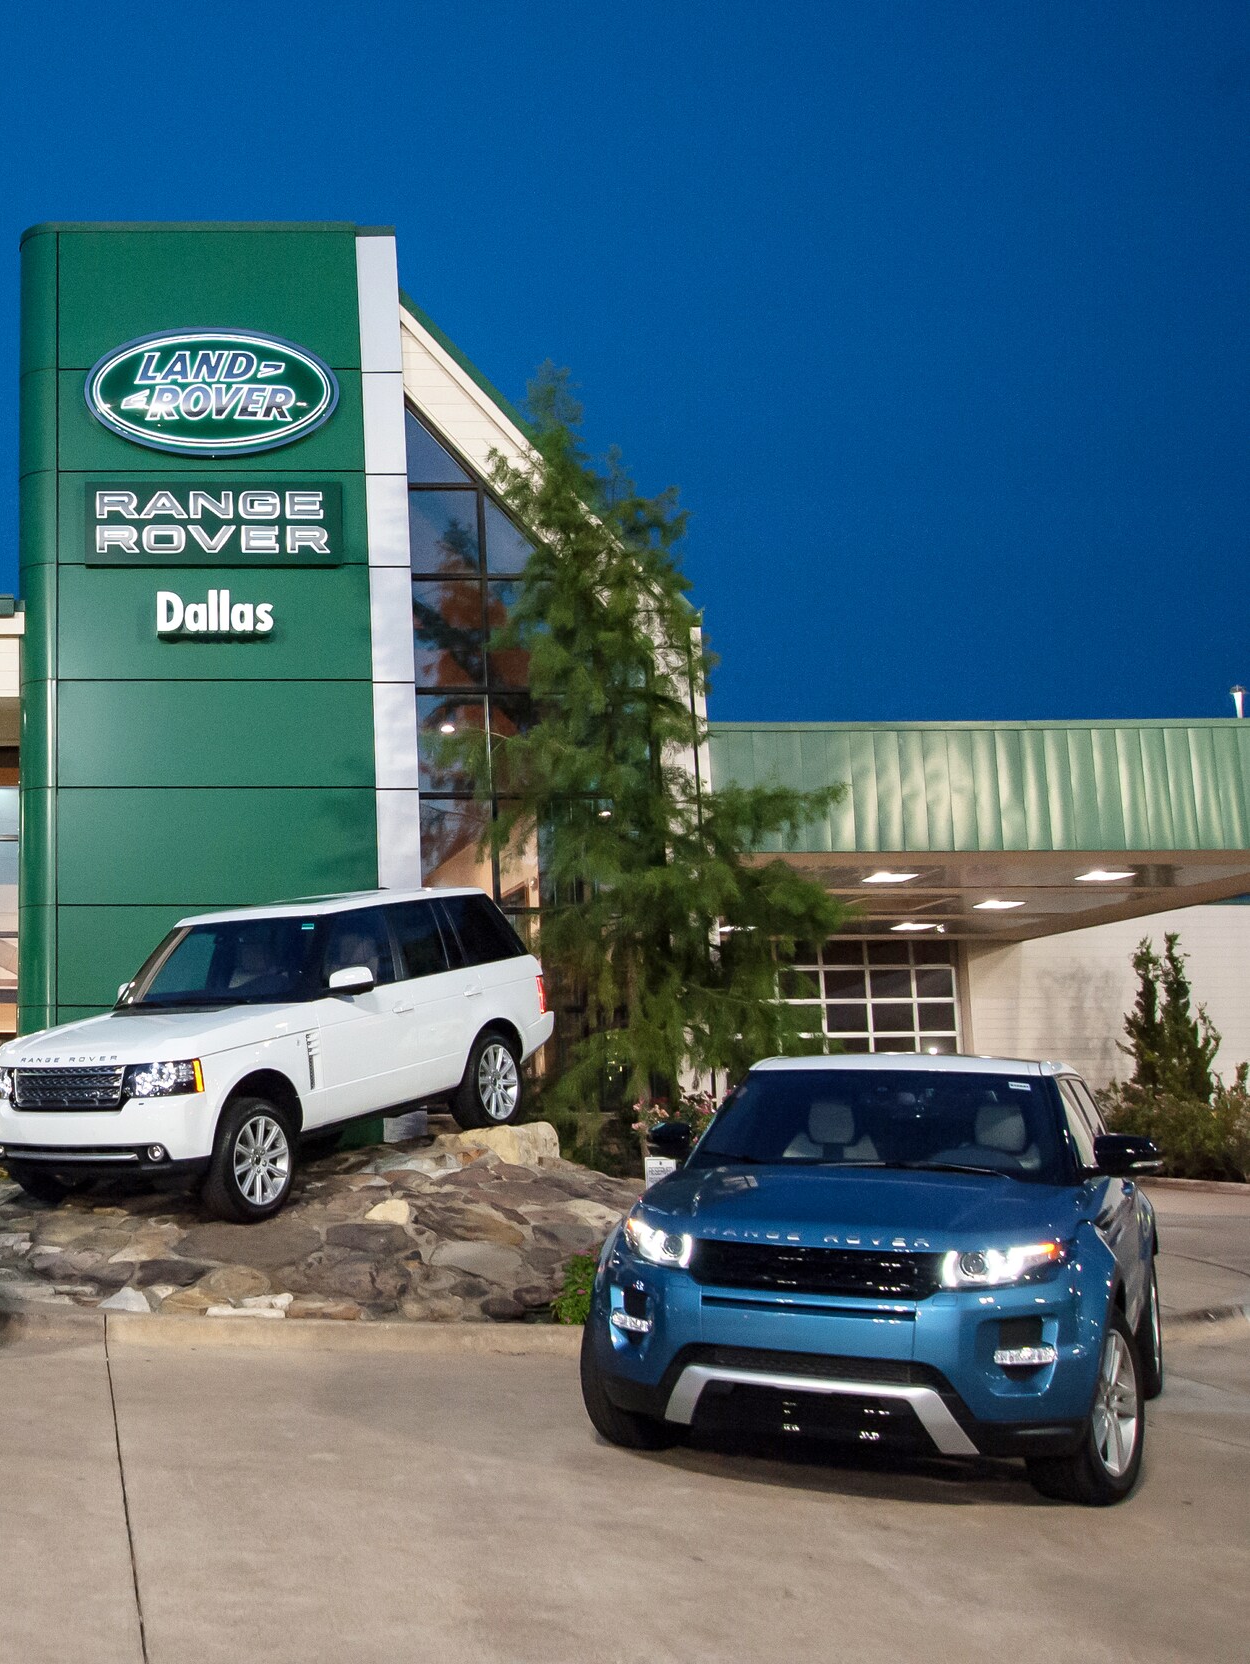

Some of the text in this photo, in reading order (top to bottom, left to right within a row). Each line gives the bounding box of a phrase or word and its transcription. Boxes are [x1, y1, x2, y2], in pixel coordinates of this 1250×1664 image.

[134, 351, 257, 384] LAND
[144, 384, 296, 421] ROVER
[96, 490, 324, 520] RANGE
[96, 525, 331, 554] ROVER
[156, 589, 274, 633] Dallas
[68, 1055, 118, 1063] ROVER
